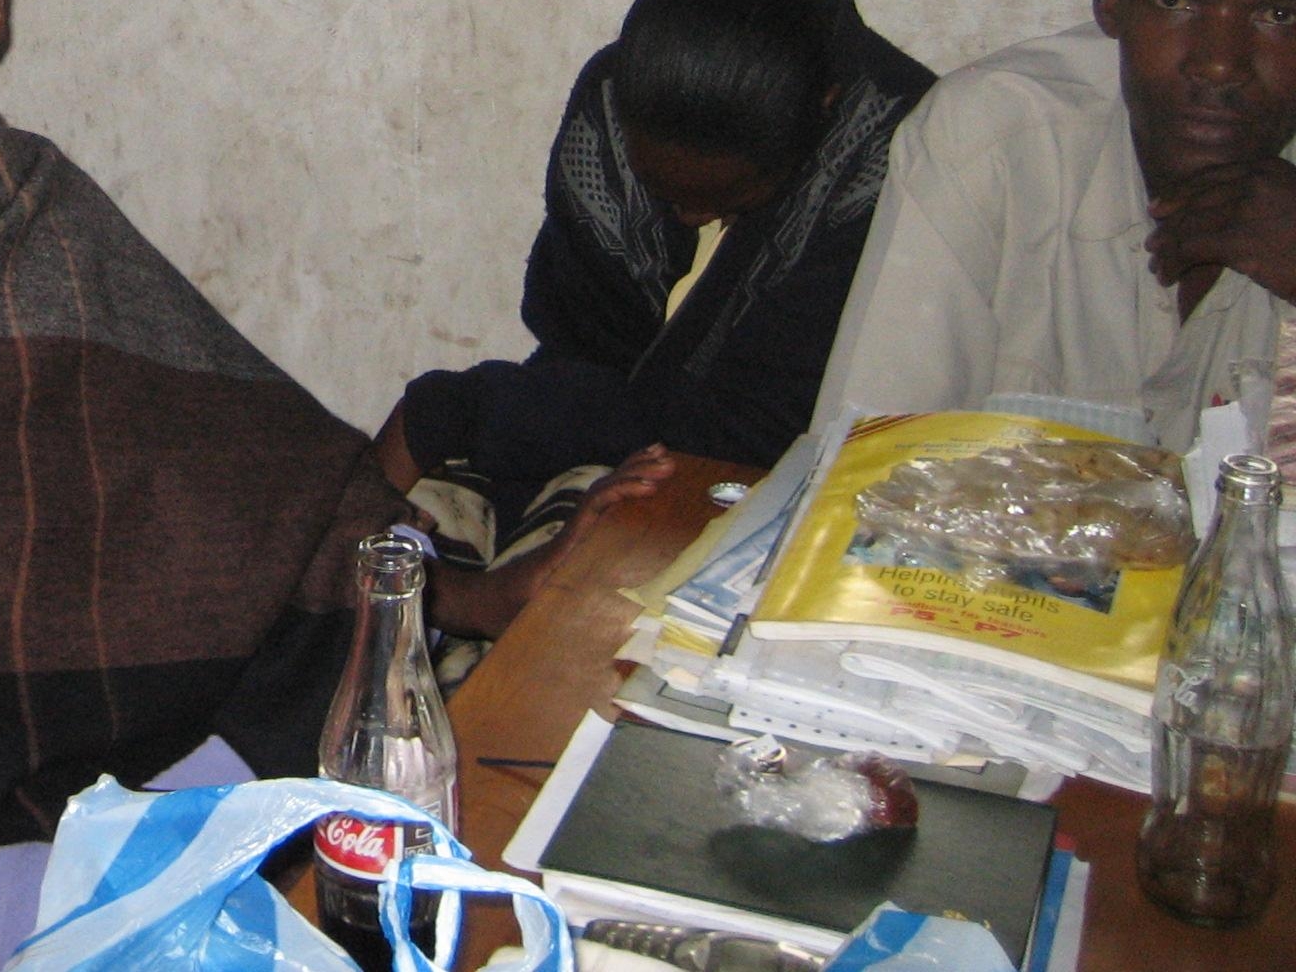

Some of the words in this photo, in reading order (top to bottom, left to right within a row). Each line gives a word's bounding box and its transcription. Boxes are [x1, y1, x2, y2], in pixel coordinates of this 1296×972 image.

[893, 582, 914, 598] to
[923, 588, 974, 608] stay
[983, 601, 1034, 623] safe
[974, 621, 1024, 639] P7
